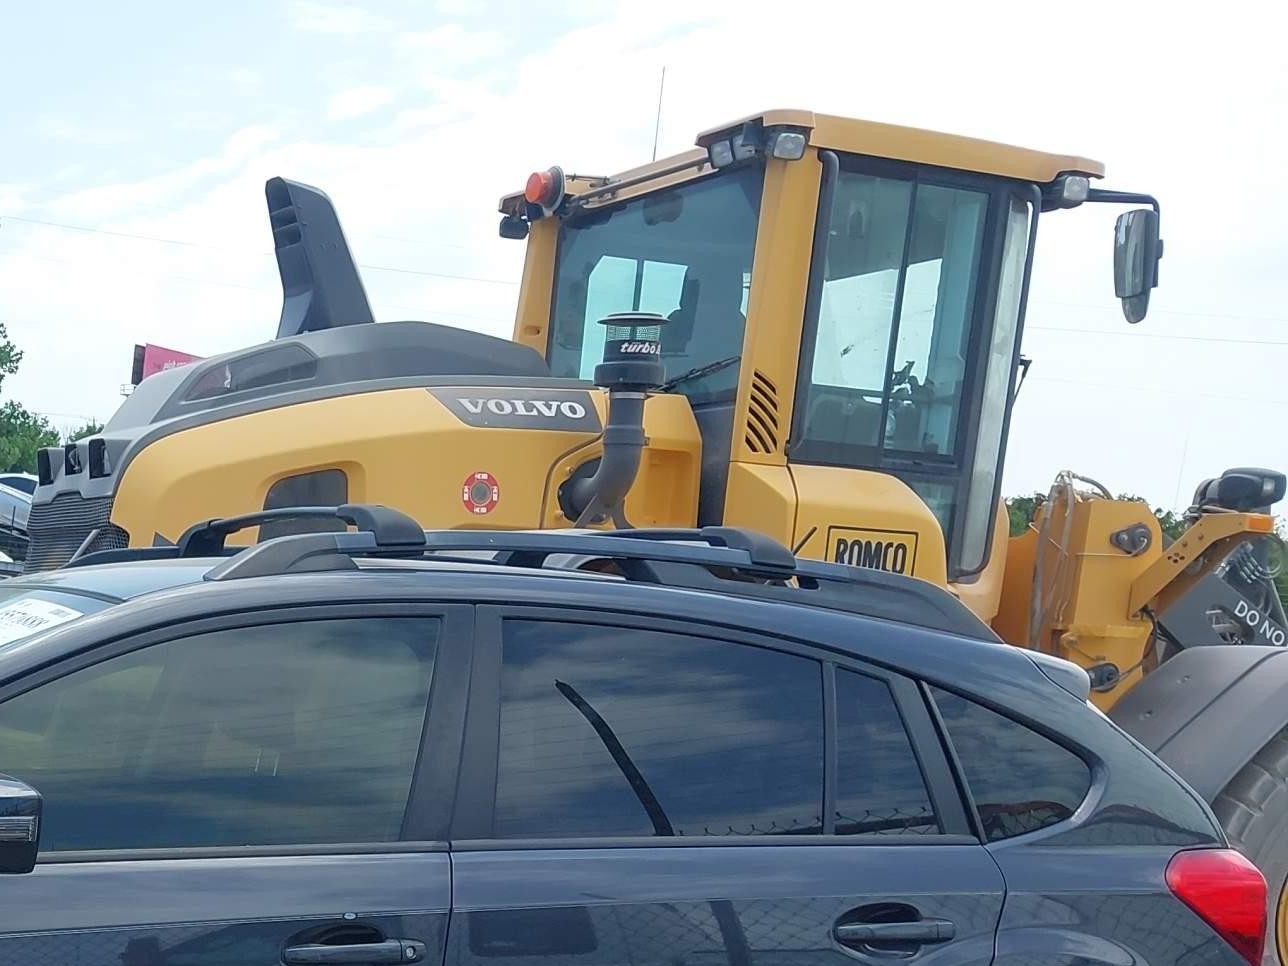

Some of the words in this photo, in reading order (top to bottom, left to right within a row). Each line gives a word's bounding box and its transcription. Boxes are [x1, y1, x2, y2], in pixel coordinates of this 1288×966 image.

[456, 398, 586, 419] VOLVO
[834, 538, 907, 574] ROMCO
[1234, 600, 1259, 626] DO
